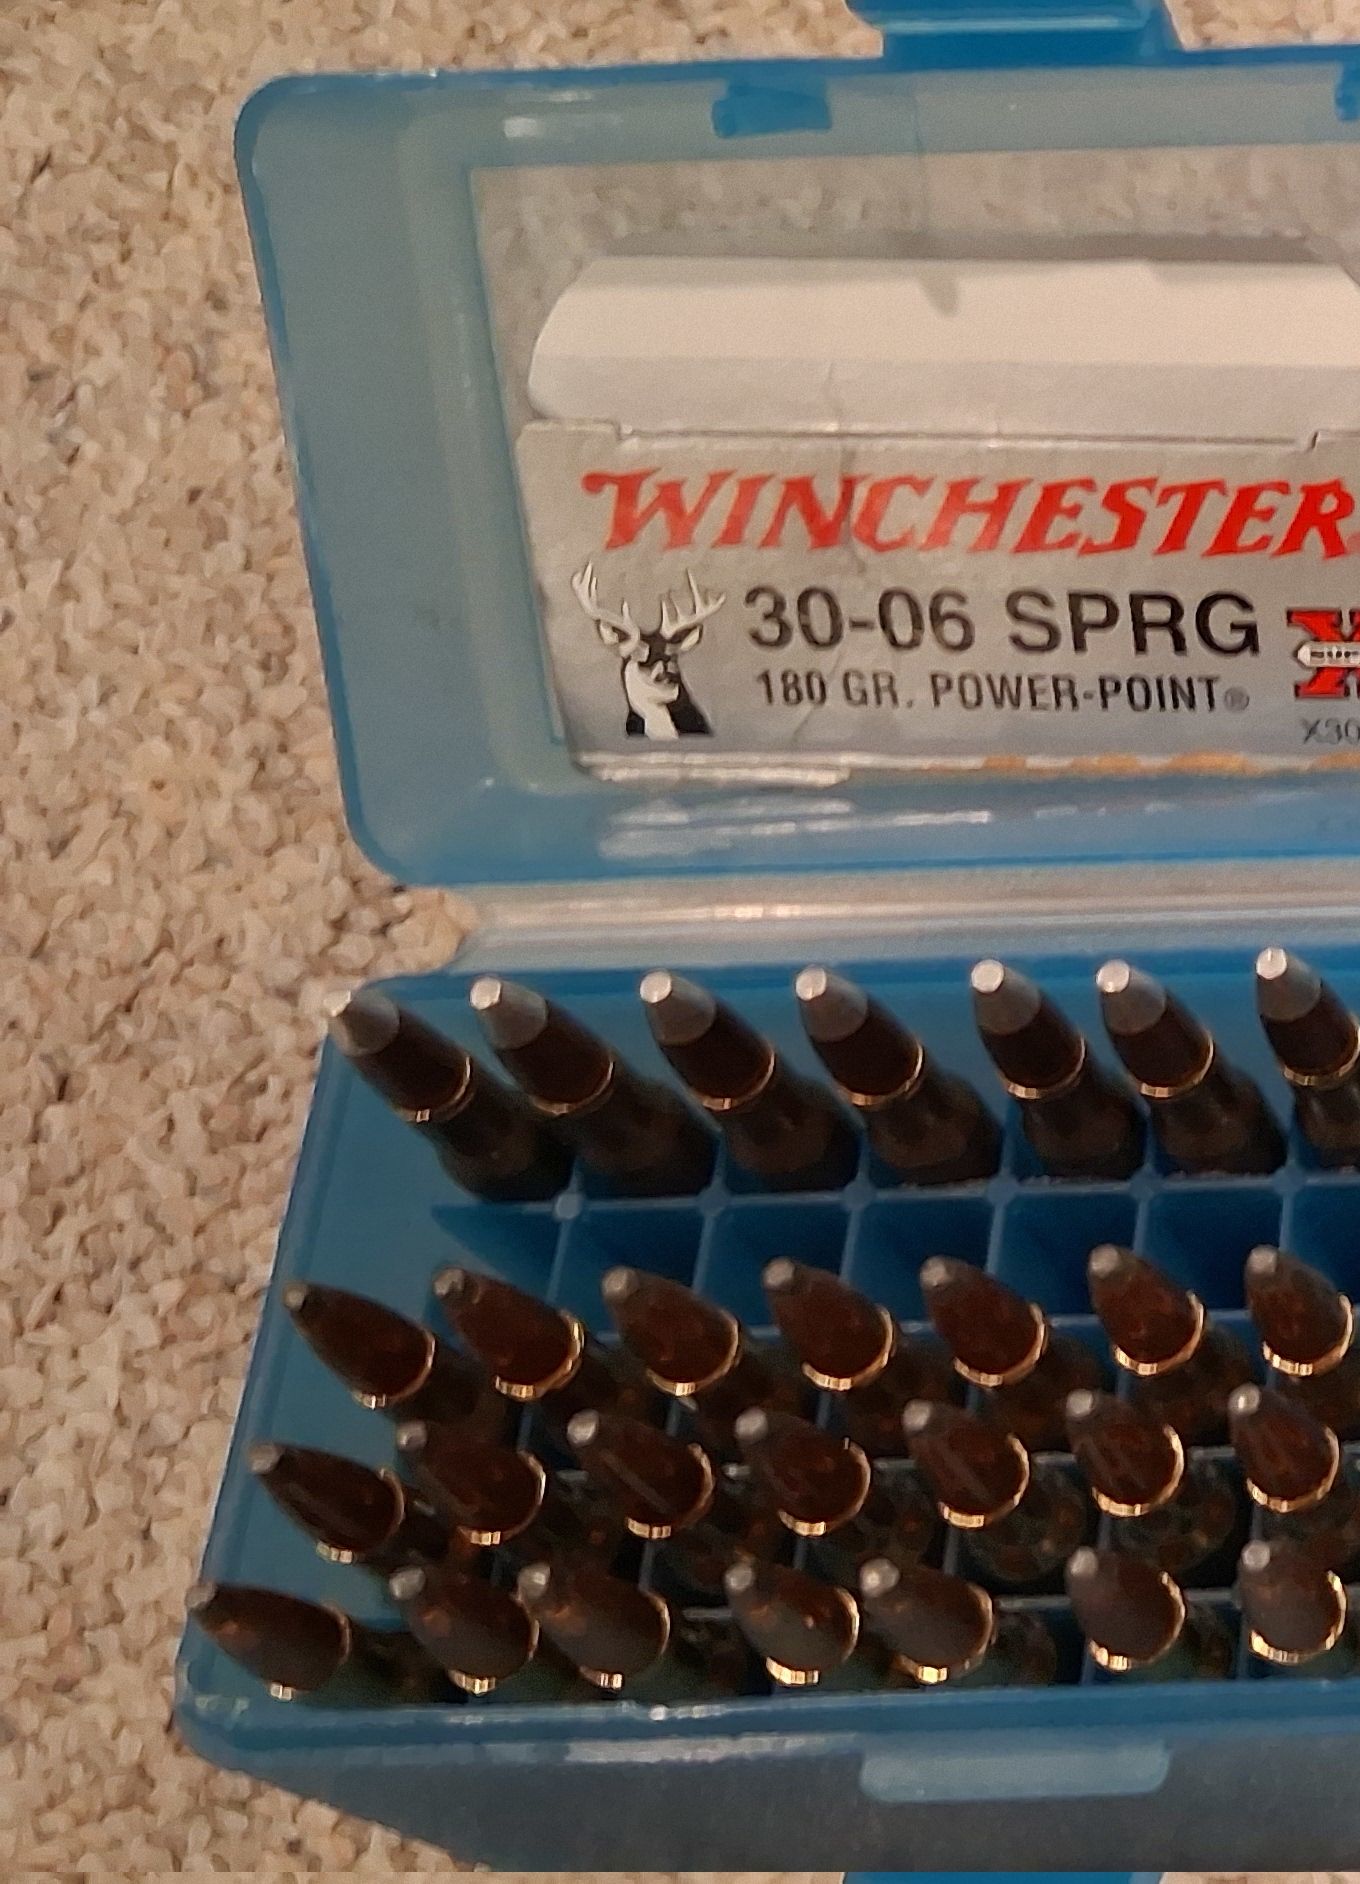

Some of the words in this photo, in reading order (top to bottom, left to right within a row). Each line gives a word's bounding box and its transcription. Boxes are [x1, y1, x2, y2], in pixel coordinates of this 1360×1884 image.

[743, 585, 976, 653] 30-06
[1004, 588, 1261, 657] SPRG
[757, 669, 828, 710] 180
[842, 670, 914, 712] GR.
